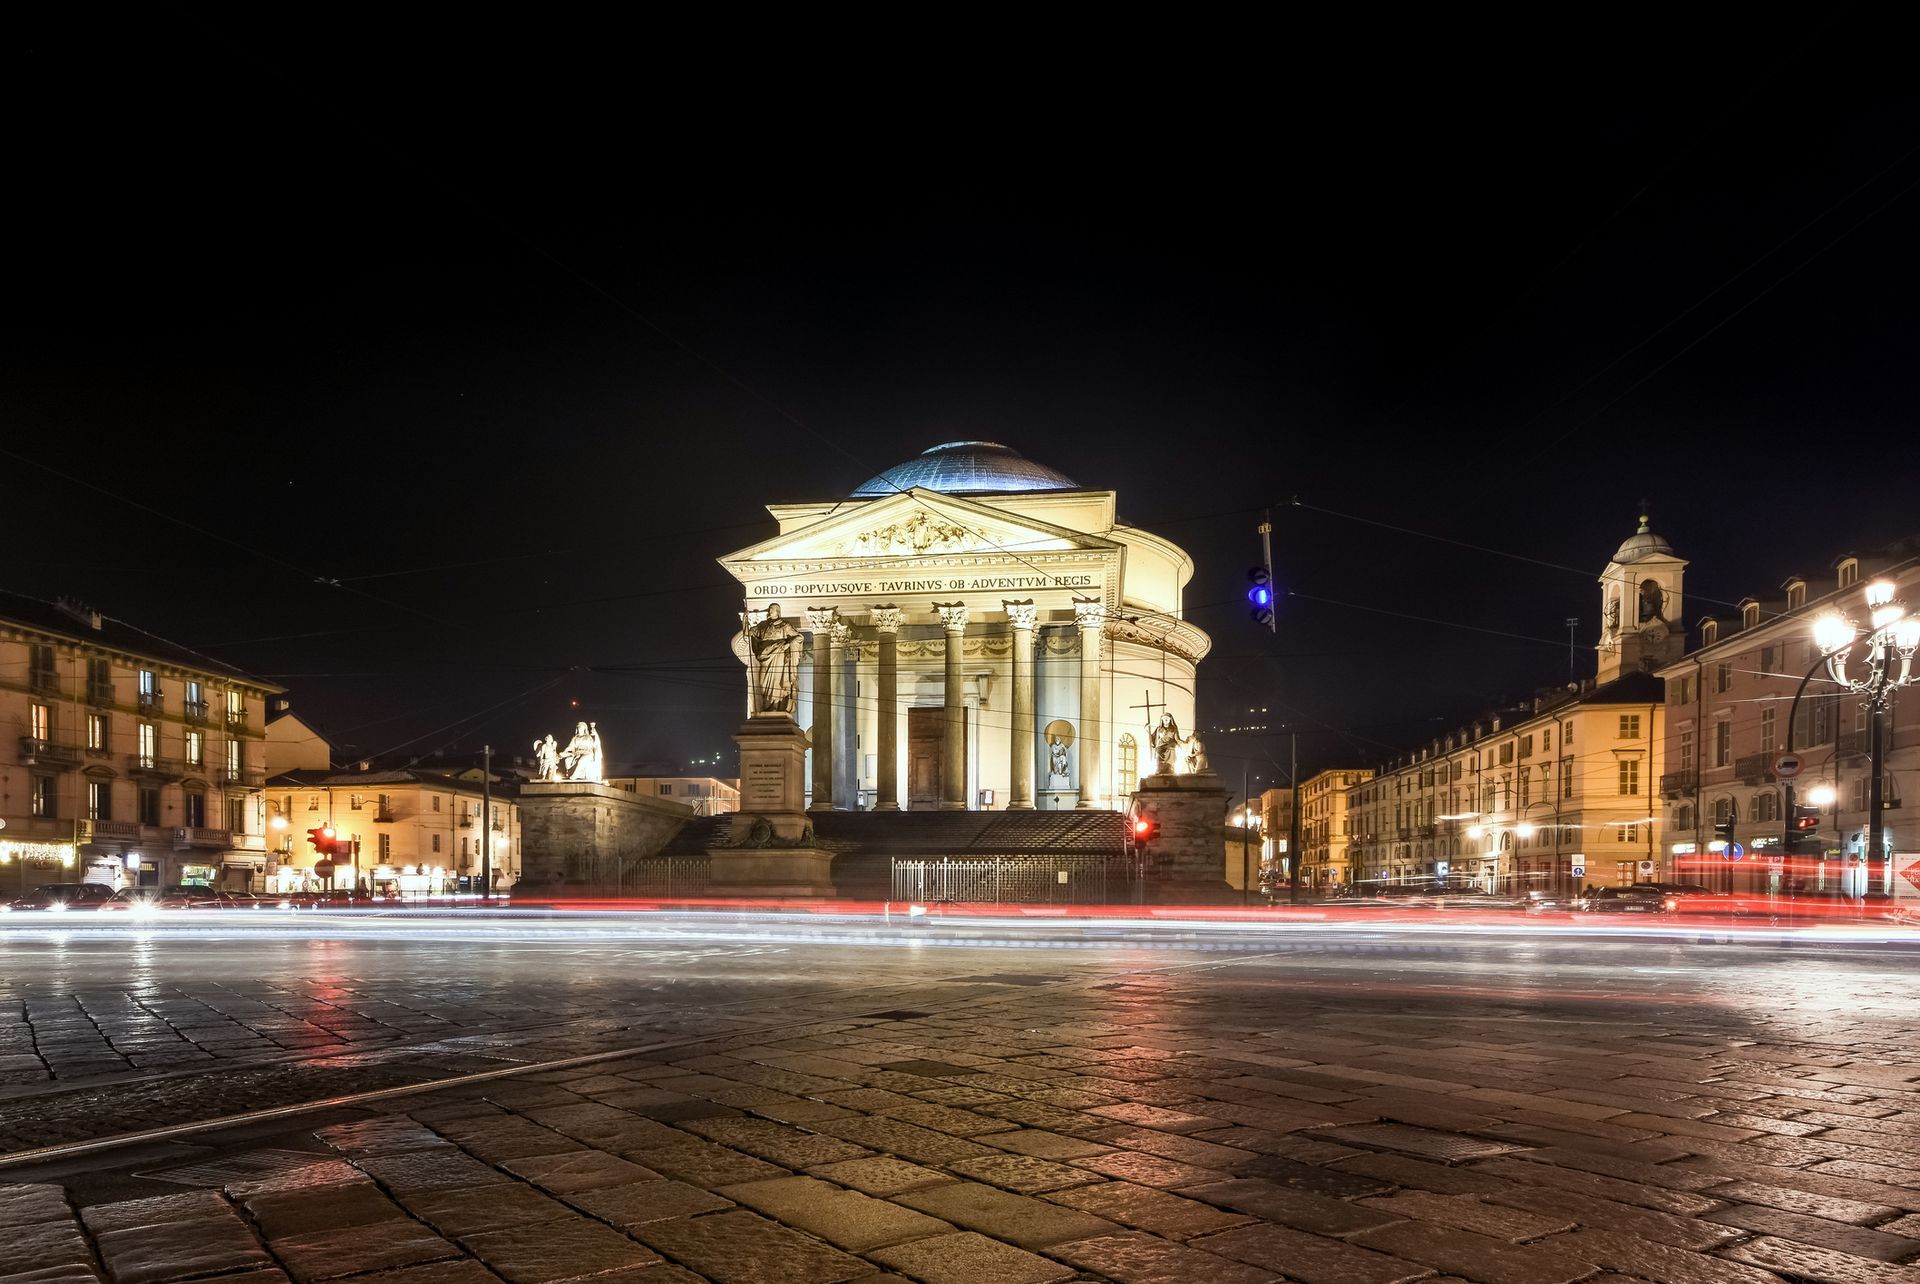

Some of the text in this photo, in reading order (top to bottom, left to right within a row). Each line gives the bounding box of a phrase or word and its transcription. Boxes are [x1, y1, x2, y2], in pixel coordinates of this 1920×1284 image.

[754, 575, 1091, 595] ORDO POPVLVSQVE TAVRINVS OB ADVENTVM REGIS
